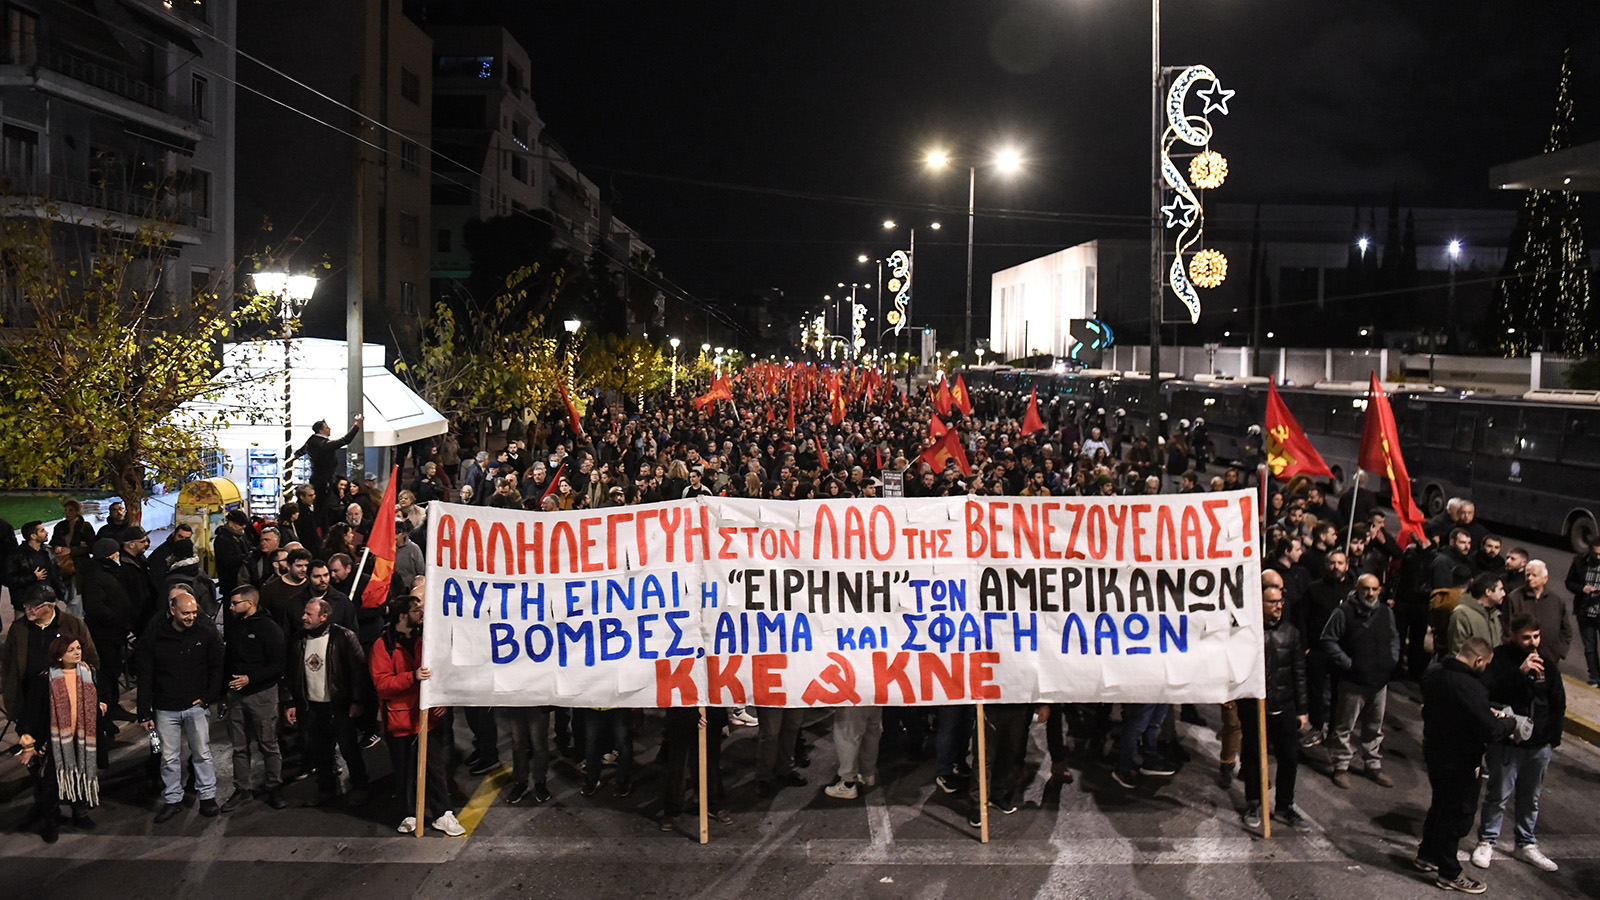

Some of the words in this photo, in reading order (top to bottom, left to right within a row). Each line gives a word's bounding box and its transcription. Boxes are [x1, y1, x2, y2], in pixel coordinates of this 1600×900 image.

[436, 505, 711, 576] ΑΛΛΗΛΕΓΓΥΗ
[717, 526, 801, 561] ΣΤΟΝ
[812, 503, 896, 562] ΛΑΟ
[901, 527, 953, 560] ΤΗΣ
[964, 496, 1253, 563] ΒΕΝΕΖΟΥΕΛΑΣ!
[442, 576, 545, 622] ΑΥΤΗ
[565, 571, 680, 618] ΕΙΝΑΙ
[701, 581, 718, 609] Η
[908, 578, 967, 614] ΤΩΝ
[979, 565, 1244, 613] ΑΜΕΡΙΚΑΝΩΝ
[489, 610, 706, 668] ΒΟΜΒΕΣ,
[714, 611, 813, 655] ΑΙΜΑ
[901, 611, 1038, 655] ΣΦΑΓΗ
[1061, 612, 1189, 656] ΛΑΩΝ
[654, 652, 788, 708] ΚΚΕ
[870, 650, 1002, 705] ΚΝΕ
